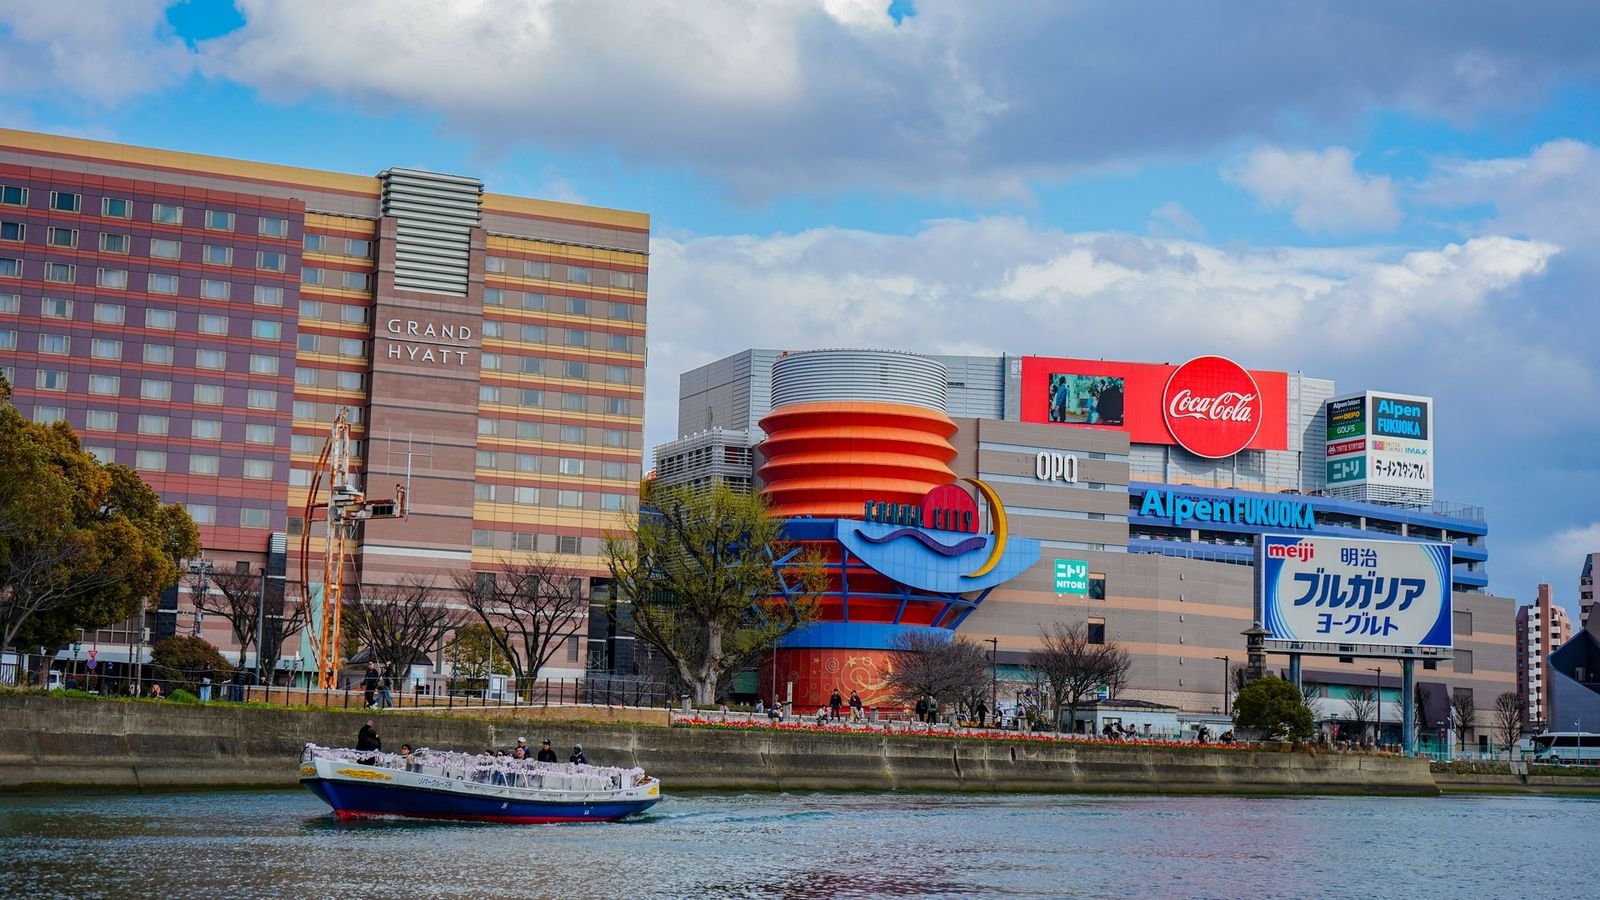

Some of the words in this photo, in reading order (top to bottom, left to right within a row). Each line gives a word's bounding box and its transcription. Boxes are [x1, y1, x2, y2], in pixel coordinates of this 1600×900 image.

[387, 319, 472, 340] GRAND
[388, 344, 468, 366] HYATT
[1169, 389, 1257, 423] Coca-Cola
[1378, 400, 1421, 418] Alpen
[1377, 418, 1421, 436] FUKUOKA
[1404, 447, 1428, 456] IMAX
[1333, 460, 1360, 480] ニトリ
[1375, 459, 1425, 480] ラーメンスタジアム
[864, 500, 924, 528] CANAL
[934, 508, 973, 533] CITY
[1140, 489, 1231, 525] Alpen
[1234, 497, 1316, 530] FUKUOKA
[1268, 542, 1315, 563] meiji
[1341, 548, 1378, 568] 明治
[1056, 564, 1086, 579] ニトリ
[1056, 580, 1086, 589] NITORI
[1294, 567, 1426, 611] ブルガリア
[1316, 612, 1399, 636] ヨーグルト
